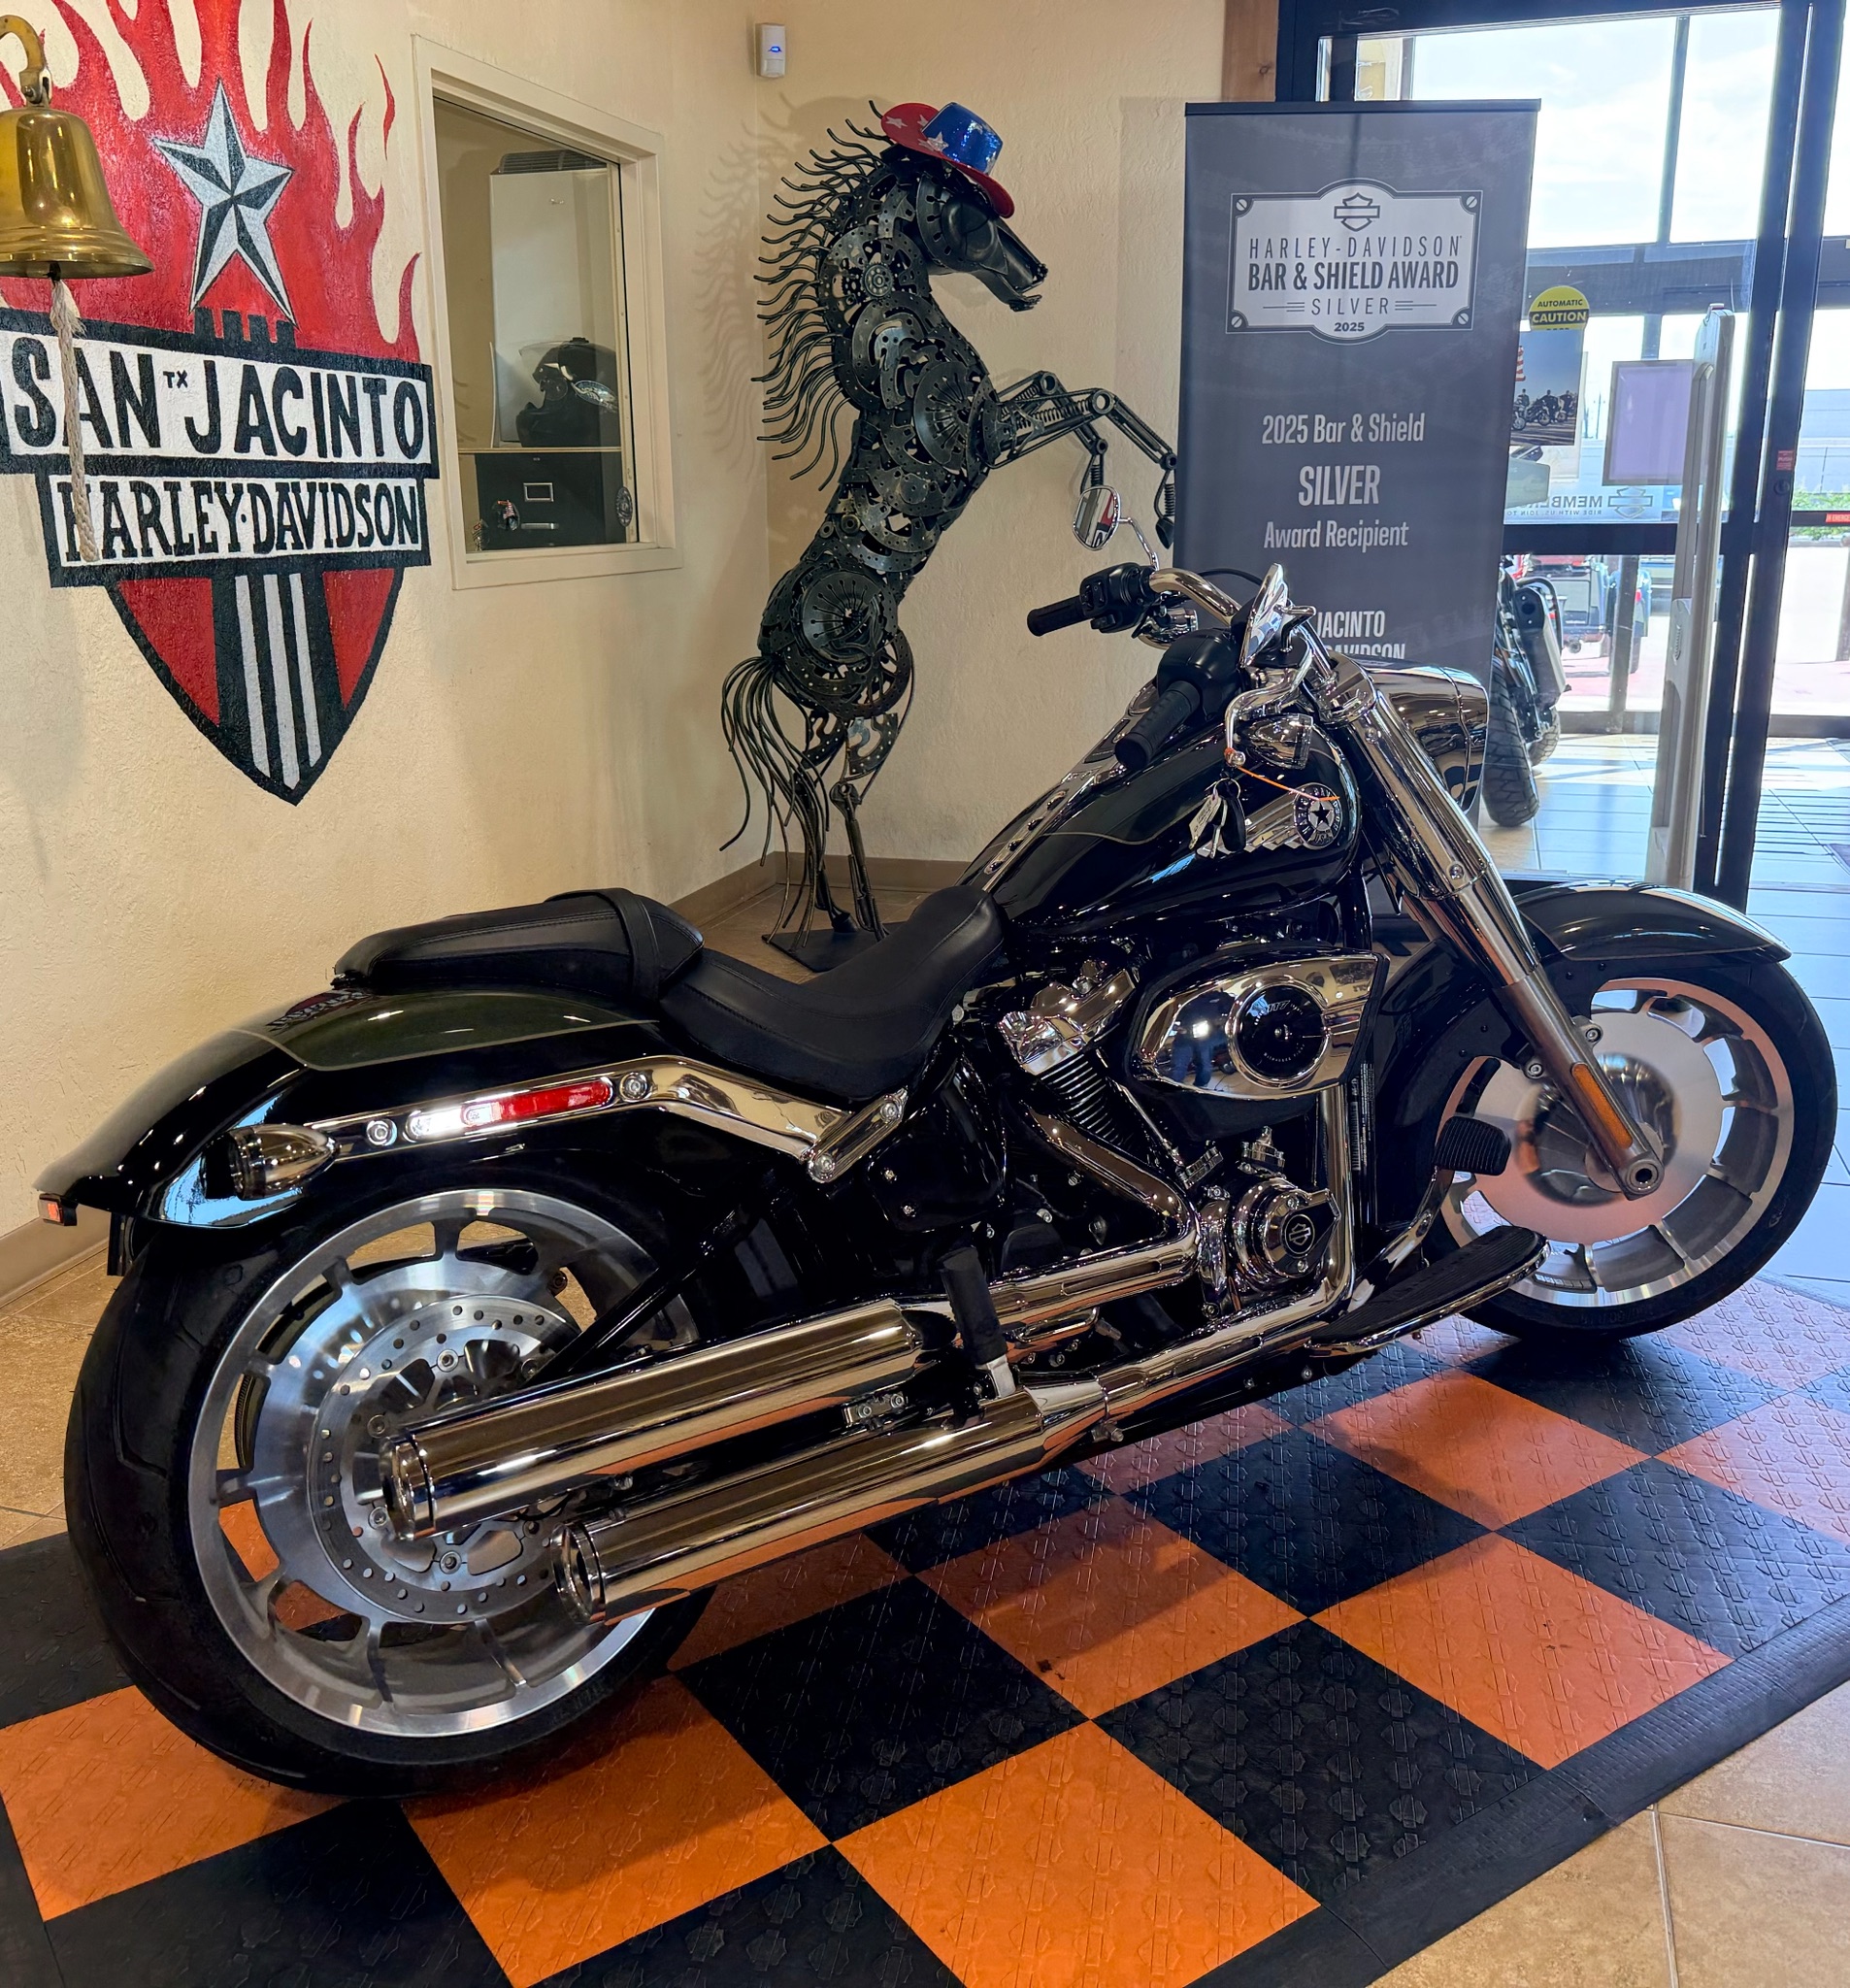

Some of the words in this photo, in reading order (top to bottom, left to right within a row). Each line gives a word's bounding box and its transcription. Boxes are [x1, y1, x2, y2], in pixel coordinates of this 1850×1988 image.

[1248, 236, 1461, 259] HARLEY-DAVIDSON
[1248, 262, 1287, 291] BAR
[1293, 262, 1308, 291] &
[1313, 261, 1384, 290] SHIELD
[1387, 260, 1460, 289] AWARD
[1310, 297, 1390, 315] SILVER
[1537, 299, 1583, 308] AUTOMATIC
[1334, 321, 1366, 333] 2025
[1532, 311, 1587, 323] CAUTION
[12, 337, 161, 448] SAN
[162, 369, 188, 388] TX
[184, 360, 424, 460] JACINTO
[1262, 414, 1308, 445] 2025
[1313, 414, 1346, 444] Bar
[1350, 414, 1364, 443] &
[1369, 413, 1426, 443] Shield
[1298, 464, 1381, 507] SILVER
[1264, 521, 1321, 548] Award
[1326, 520, 1409, 553] Recipient
[1317, 610, 1386, 639] JACINTO
[1326, 643, 1405, 660] DSON
